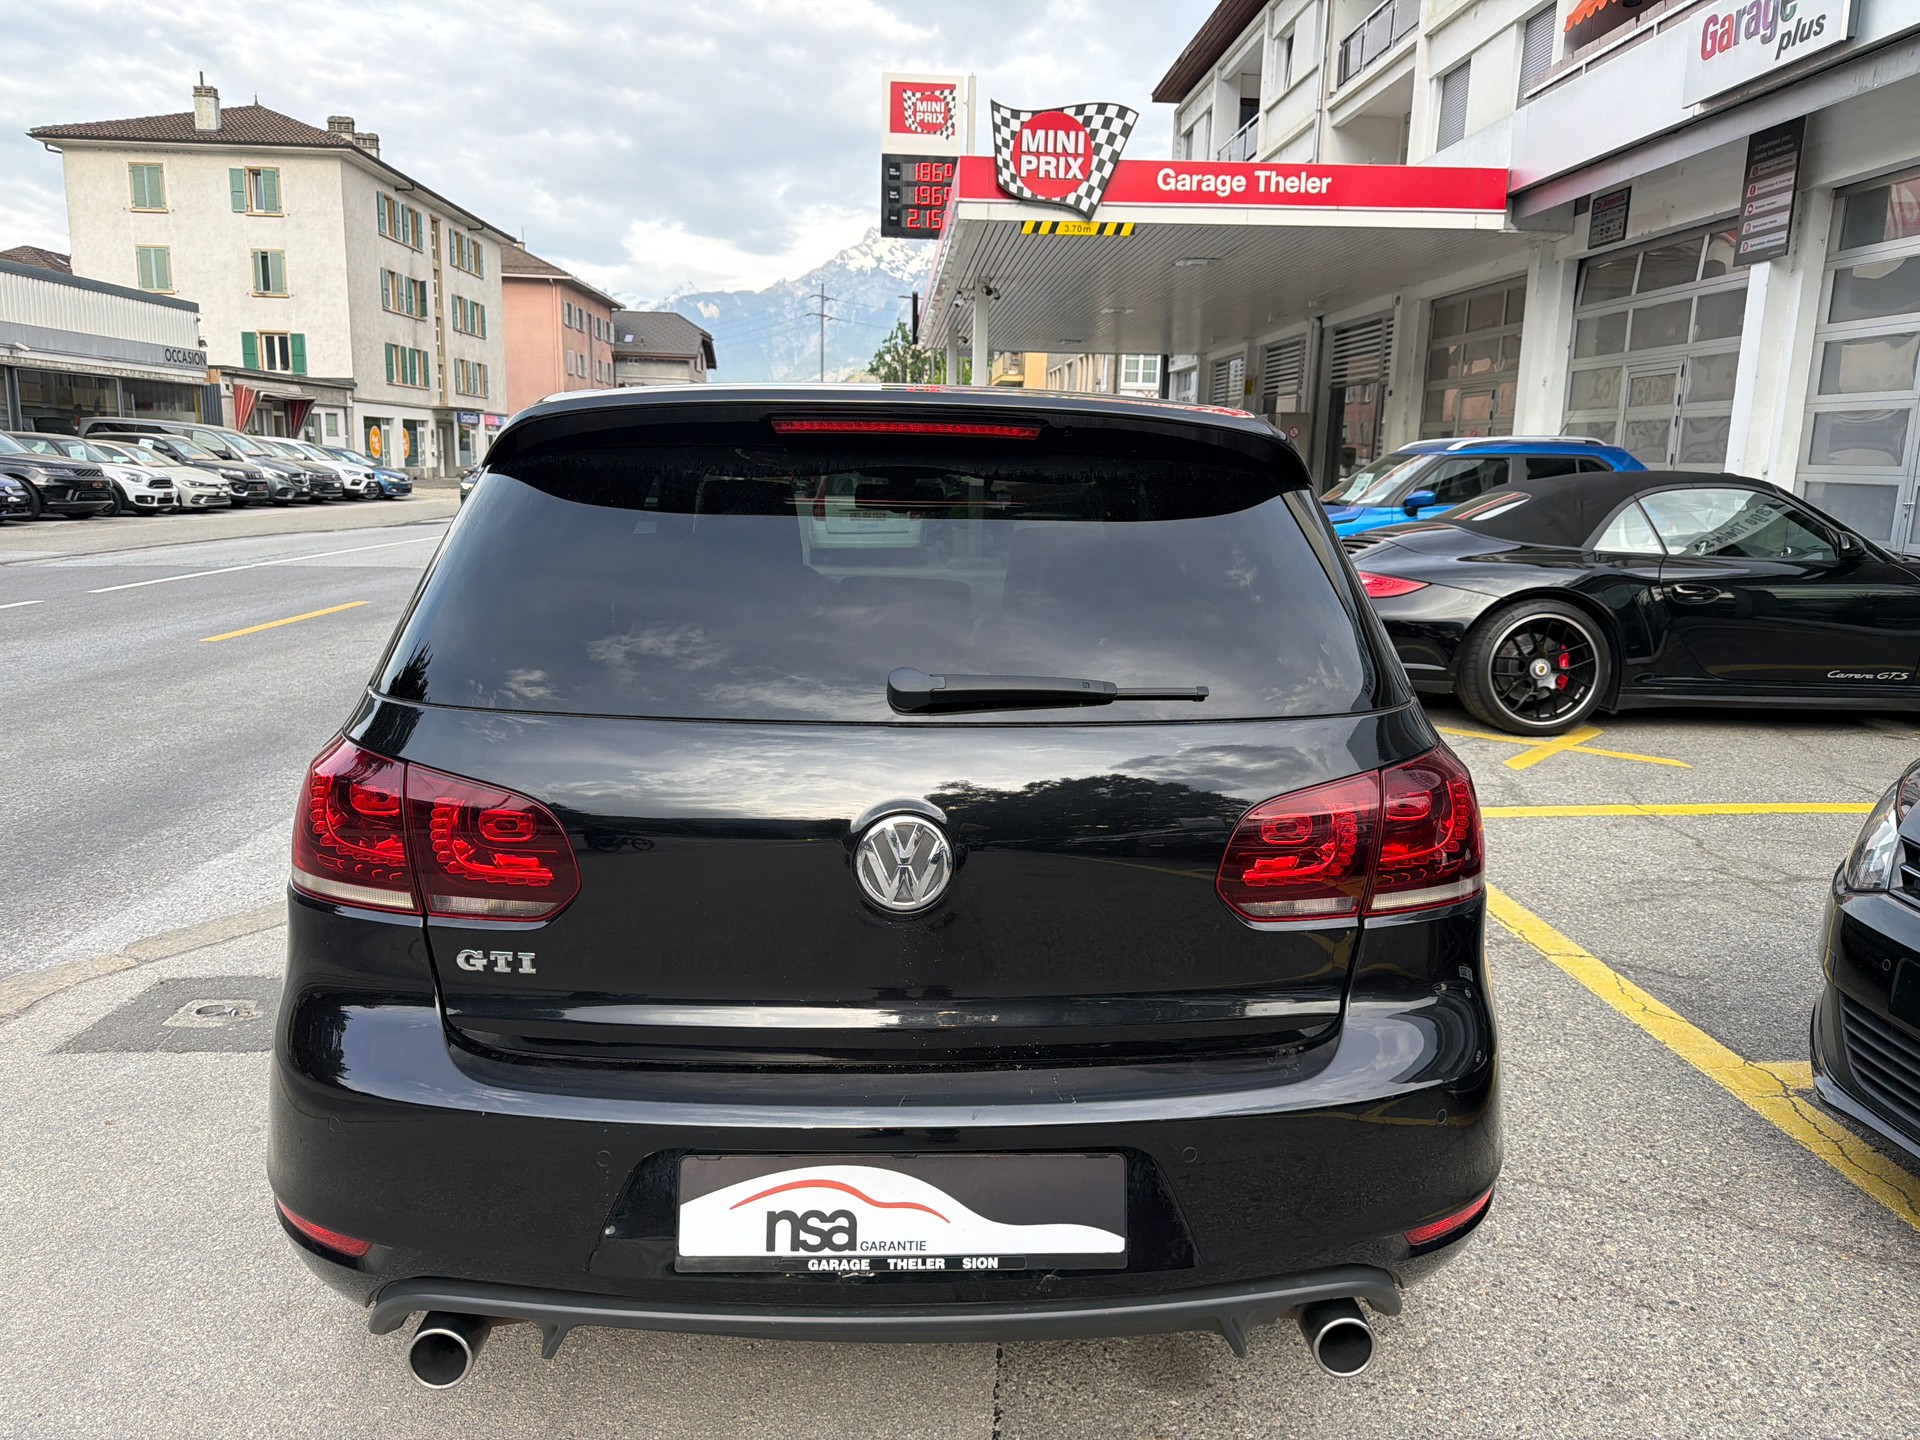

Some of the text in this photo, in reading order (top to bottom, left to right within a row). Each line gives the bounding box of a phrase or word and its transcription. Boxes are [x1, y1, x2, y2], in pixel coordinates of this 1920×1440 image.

[1700, 0, 1798, 61] Garage
[1775, 13, 1827, 61] plus
[916, 100, 945, 113] MINI
[916, 112, 945, 124] PRIX
[1021, 128, 1086, 155] MINI
[1020, 154, 1085, 180] PRIX
[1157, 167, 1333, 198] Garage Theler
[165, 348, 207, 366] OCCASION
[1827, 669, 1911, 680] Carrera GTS
[456, 949, 538, 975] GTI
[766, 1209, 858, 1253] nsa
[860, 1240, 927, 1252] GARANTIE
[807, 1256, 999, 1271] GARAGE THELER SION
